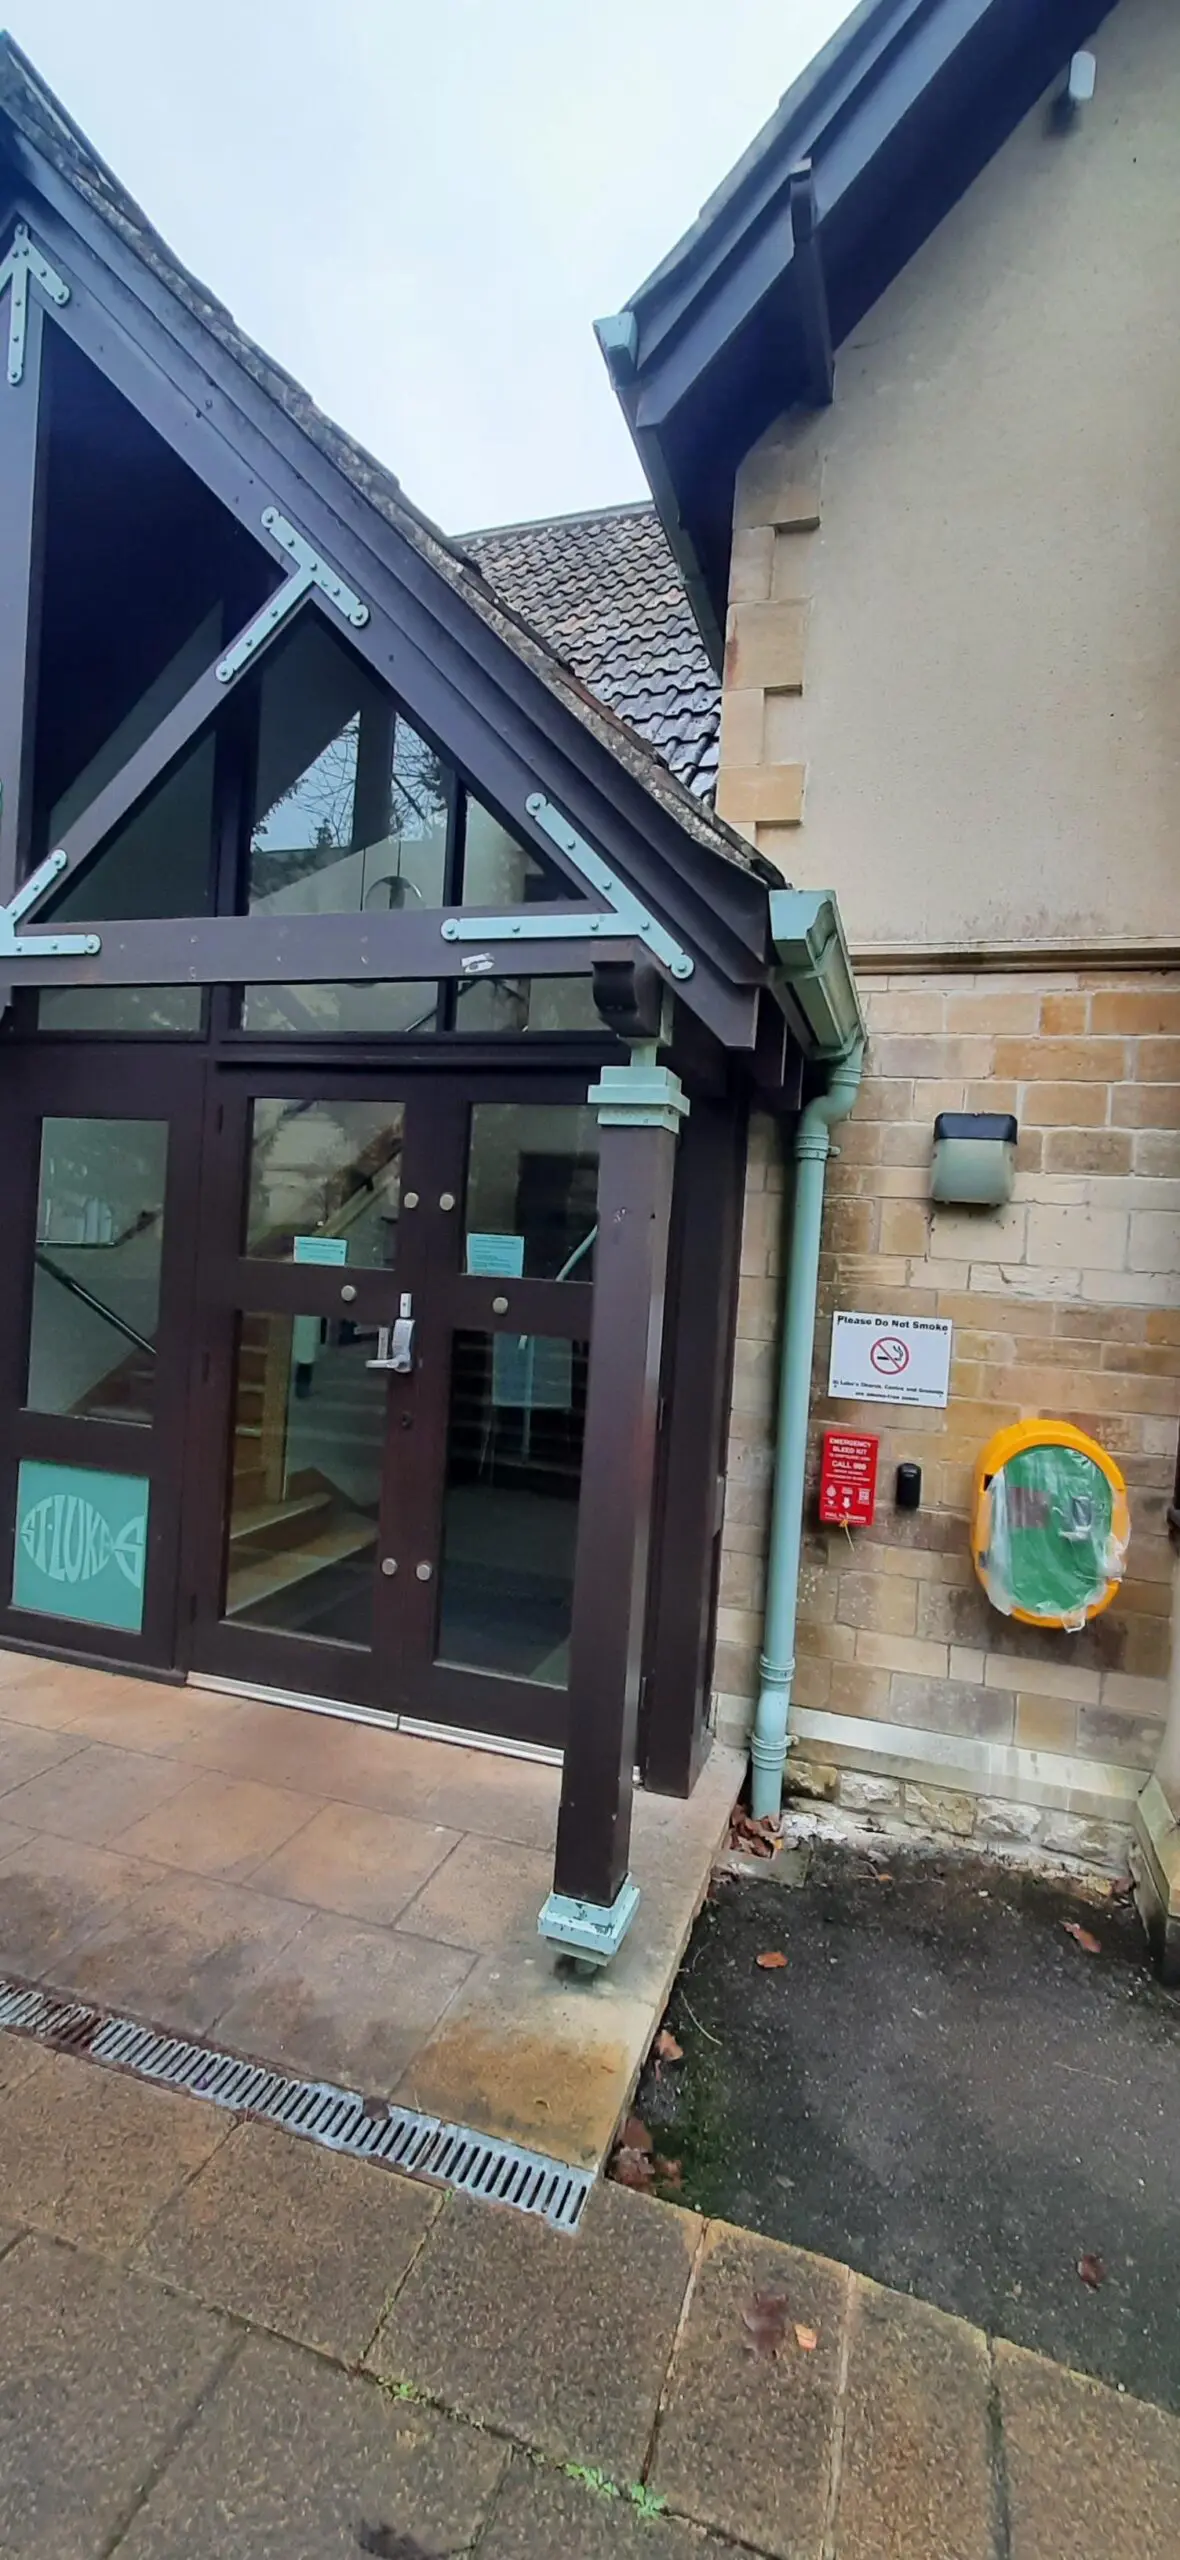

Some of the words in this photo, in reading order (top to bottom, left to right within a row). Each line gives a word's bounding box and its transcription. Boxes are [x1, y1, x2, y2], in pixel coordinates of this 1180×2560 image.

[837, 1315, 872, 1325] Please
[875, 1318, 889, 1327] Do
[891, 1319, 910, 1329] Not
[912, 1321, 949, 1332] Smoke
[829, 1437, 872, 1448] EMERGENCY
[832, 1445, 855, 1454] BLEED
[831, 1460, 852, 1469] CALL
